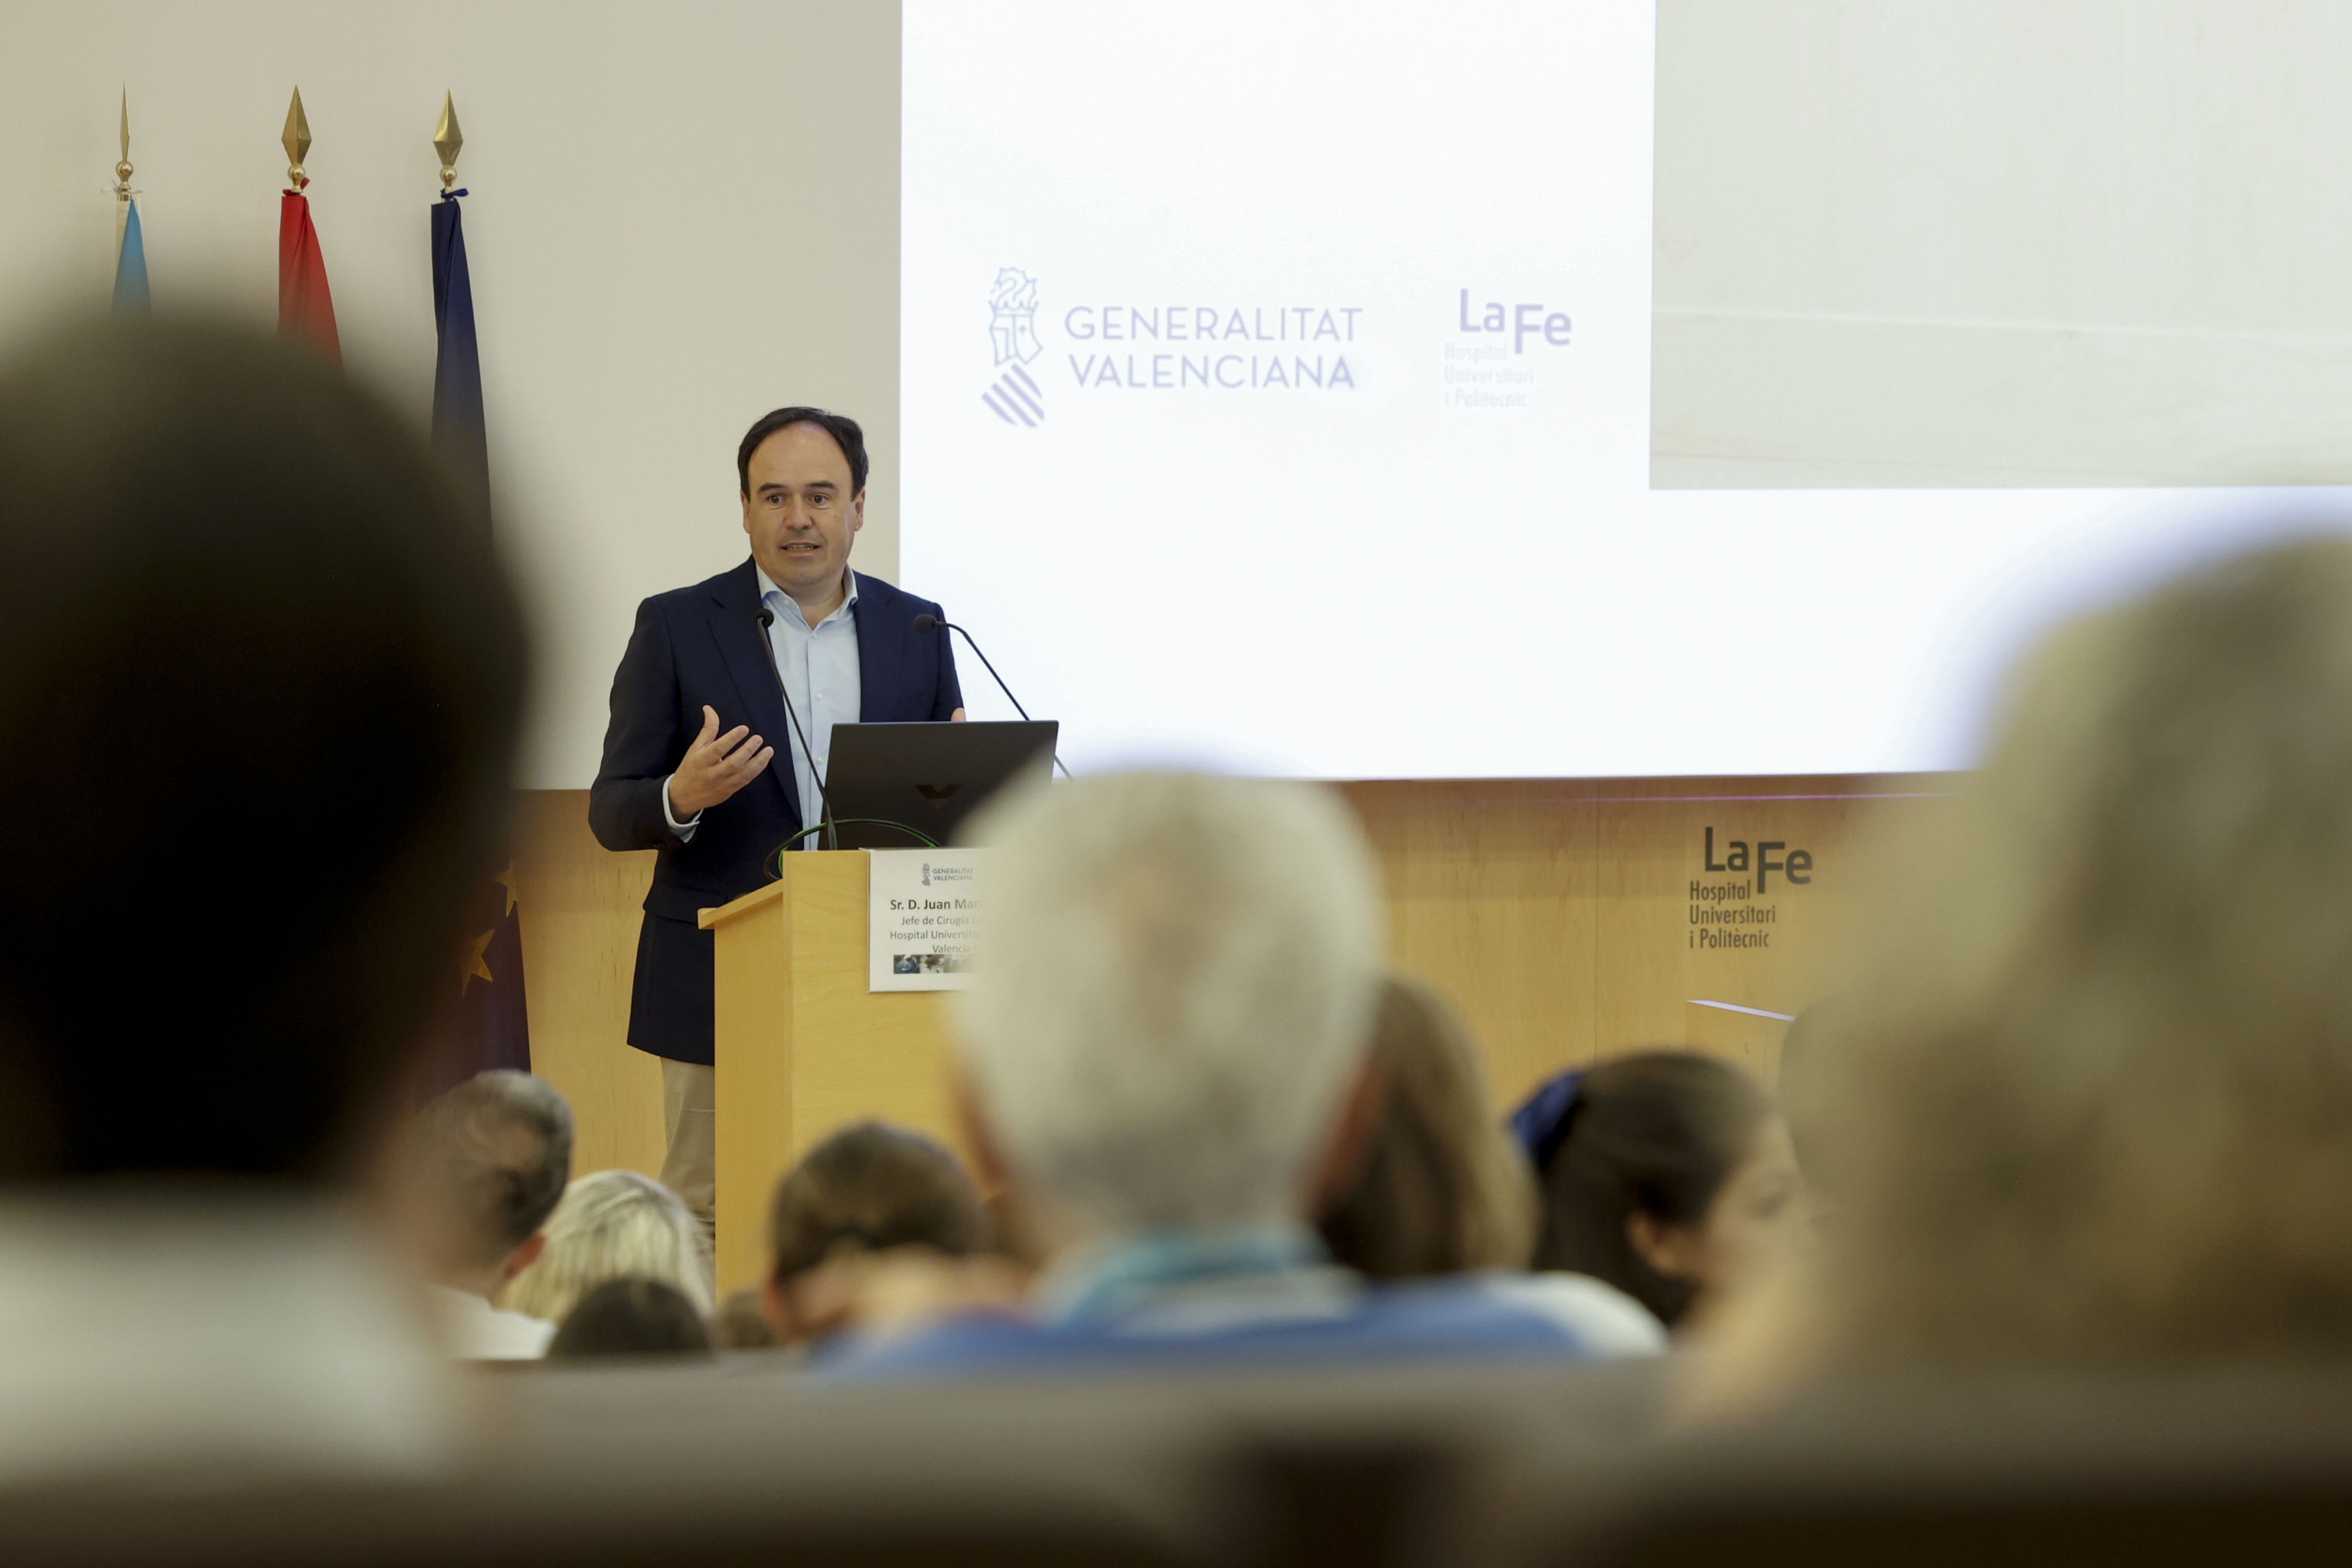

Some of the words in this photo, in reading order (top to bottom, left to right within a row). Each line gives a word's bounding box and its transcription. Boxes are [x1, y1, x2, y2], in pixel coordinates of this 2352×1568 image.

[1064, 305, 1364, 342] GENERALITAT
[1444, 341, 1508, 364] Hospital
[1068, 353, 1357, 390] VALENCIANA
[1690, 879, 1751, 905] Hospital
[890, 899, 905, 910] Sr.
[908, 899, 920, 910] D.
[923, 899, 951, 910] Juan
[1689, 904, 1775, 925] Universitari
[900, 916, 920, 926] Jefe
[922, 916, 934, 926] de
[936, 916, 969, 926] Cirugía
[890, 930, 929, 942] Hospital
[1690, 930, 1694, 949] i
[1700, 927, 1769, 949] Politècnic
[932, 943, 971, 953] Valencia
